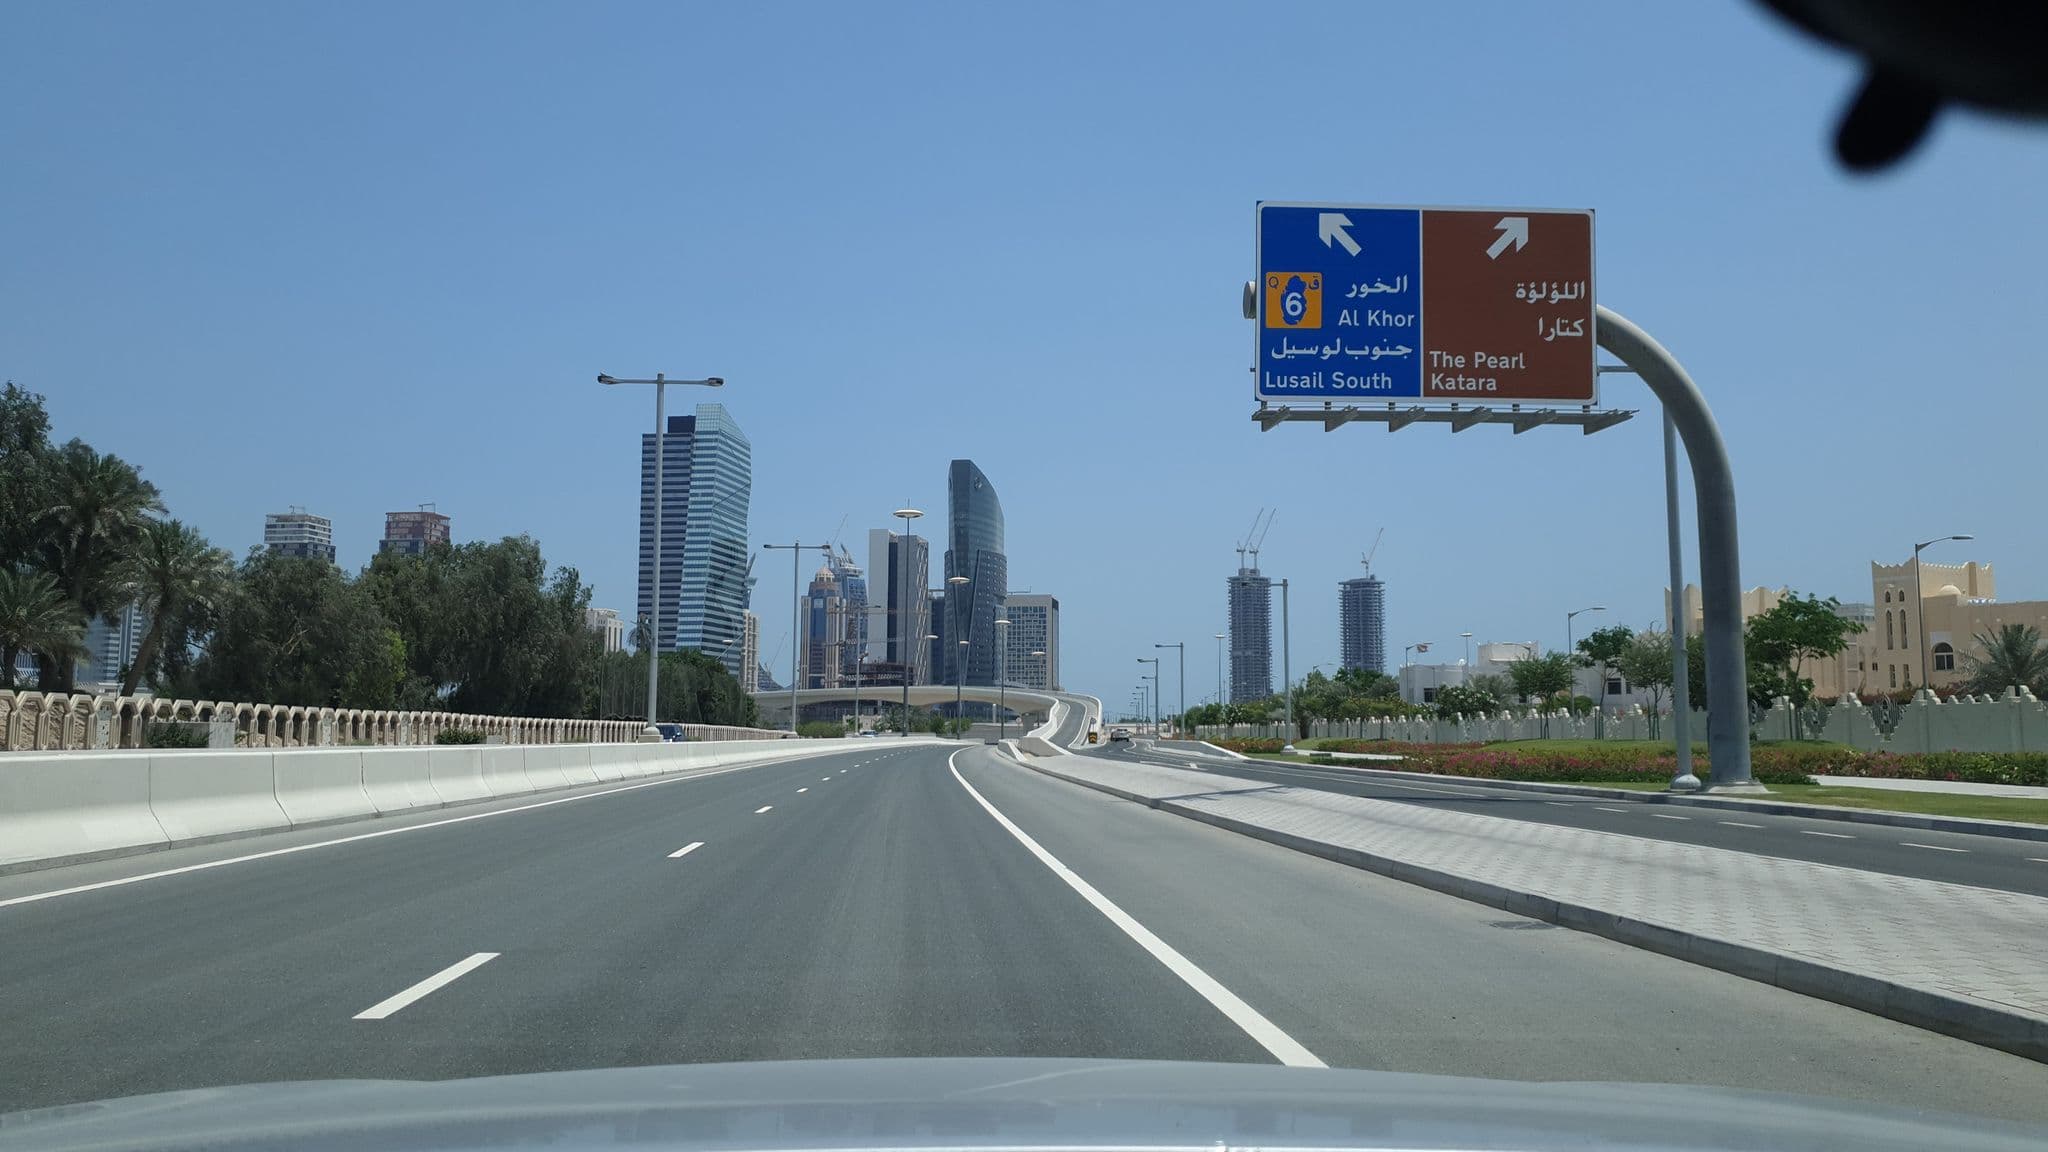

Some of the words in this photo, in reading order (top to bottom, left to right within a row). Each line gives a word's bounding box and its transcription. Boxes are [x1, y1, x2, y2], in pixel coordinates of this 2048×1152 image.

[1268, 276, 1279, 289] Q
[1346, 275, 1407, 297] الخور
[1516, 281, 1585, 304] اللؤلؤة
[1286, 293, 1301, 315] 6
[1339, 310, 1359, 326] Al
[1368, 310, 1414, 326] Khor
[1539, 317, 1584, 341] كتارا
[1272, 337, 1340, 359] لوسيل
[1345, 339, 1412, 360] جنوب
[1430, 351, 1465, 368] The
[1475, 352, 1525, 369] Pearl
[1266, 372, 1324, 388] Lusail
[1332, 372, 1391, 389] South
[1432, 373, 1496, 390] Katara
